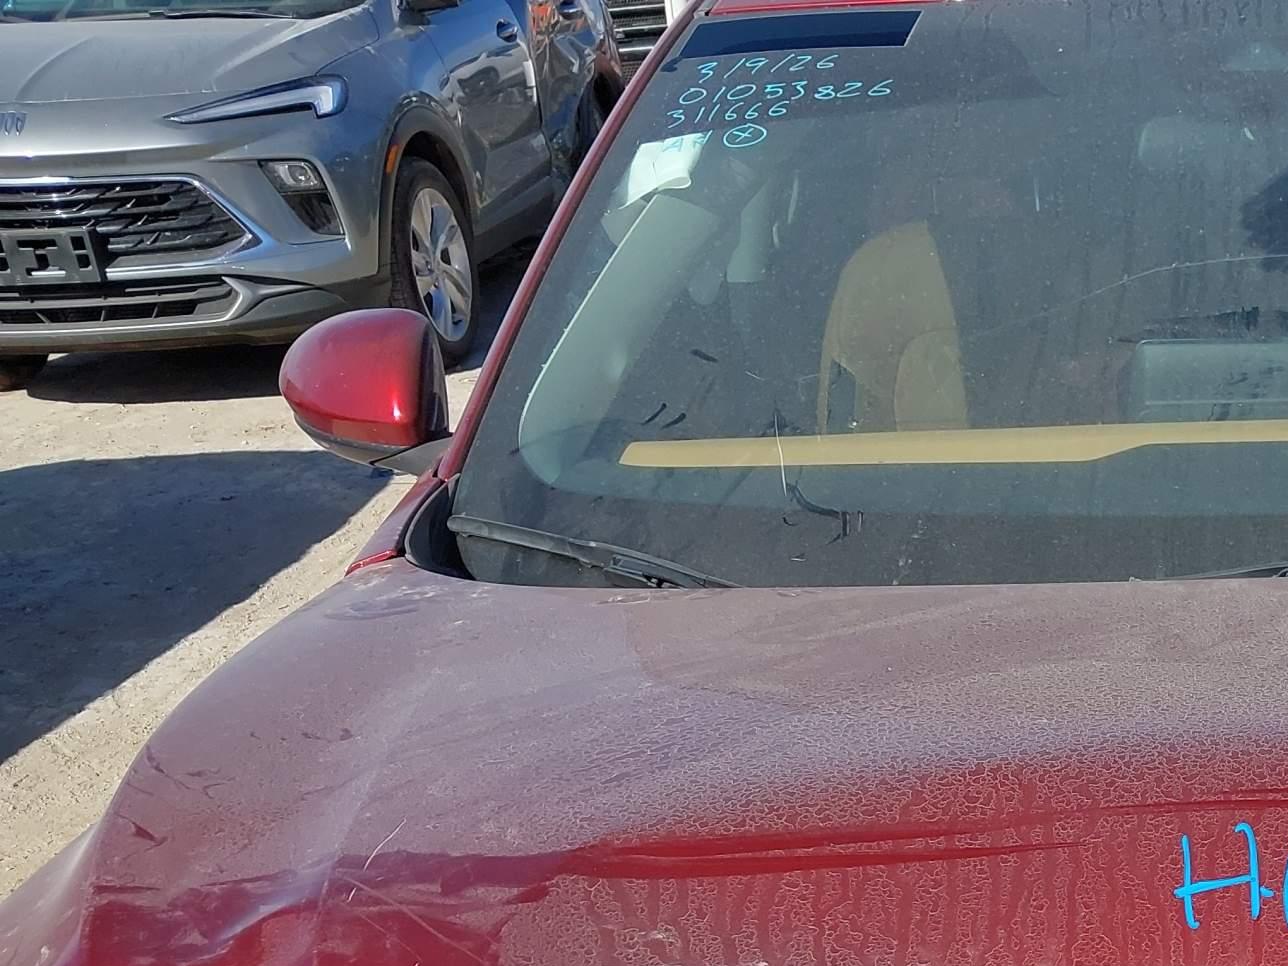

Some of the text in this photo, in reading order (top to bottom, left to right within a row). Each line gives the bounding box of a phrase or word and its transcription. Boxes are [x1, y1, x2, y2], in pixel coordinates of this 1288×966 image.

[696, 53, 840, 84] 3/9/26
[678, 79, 895, 105] 01053826
[666, 100, 790, 129] 311666
